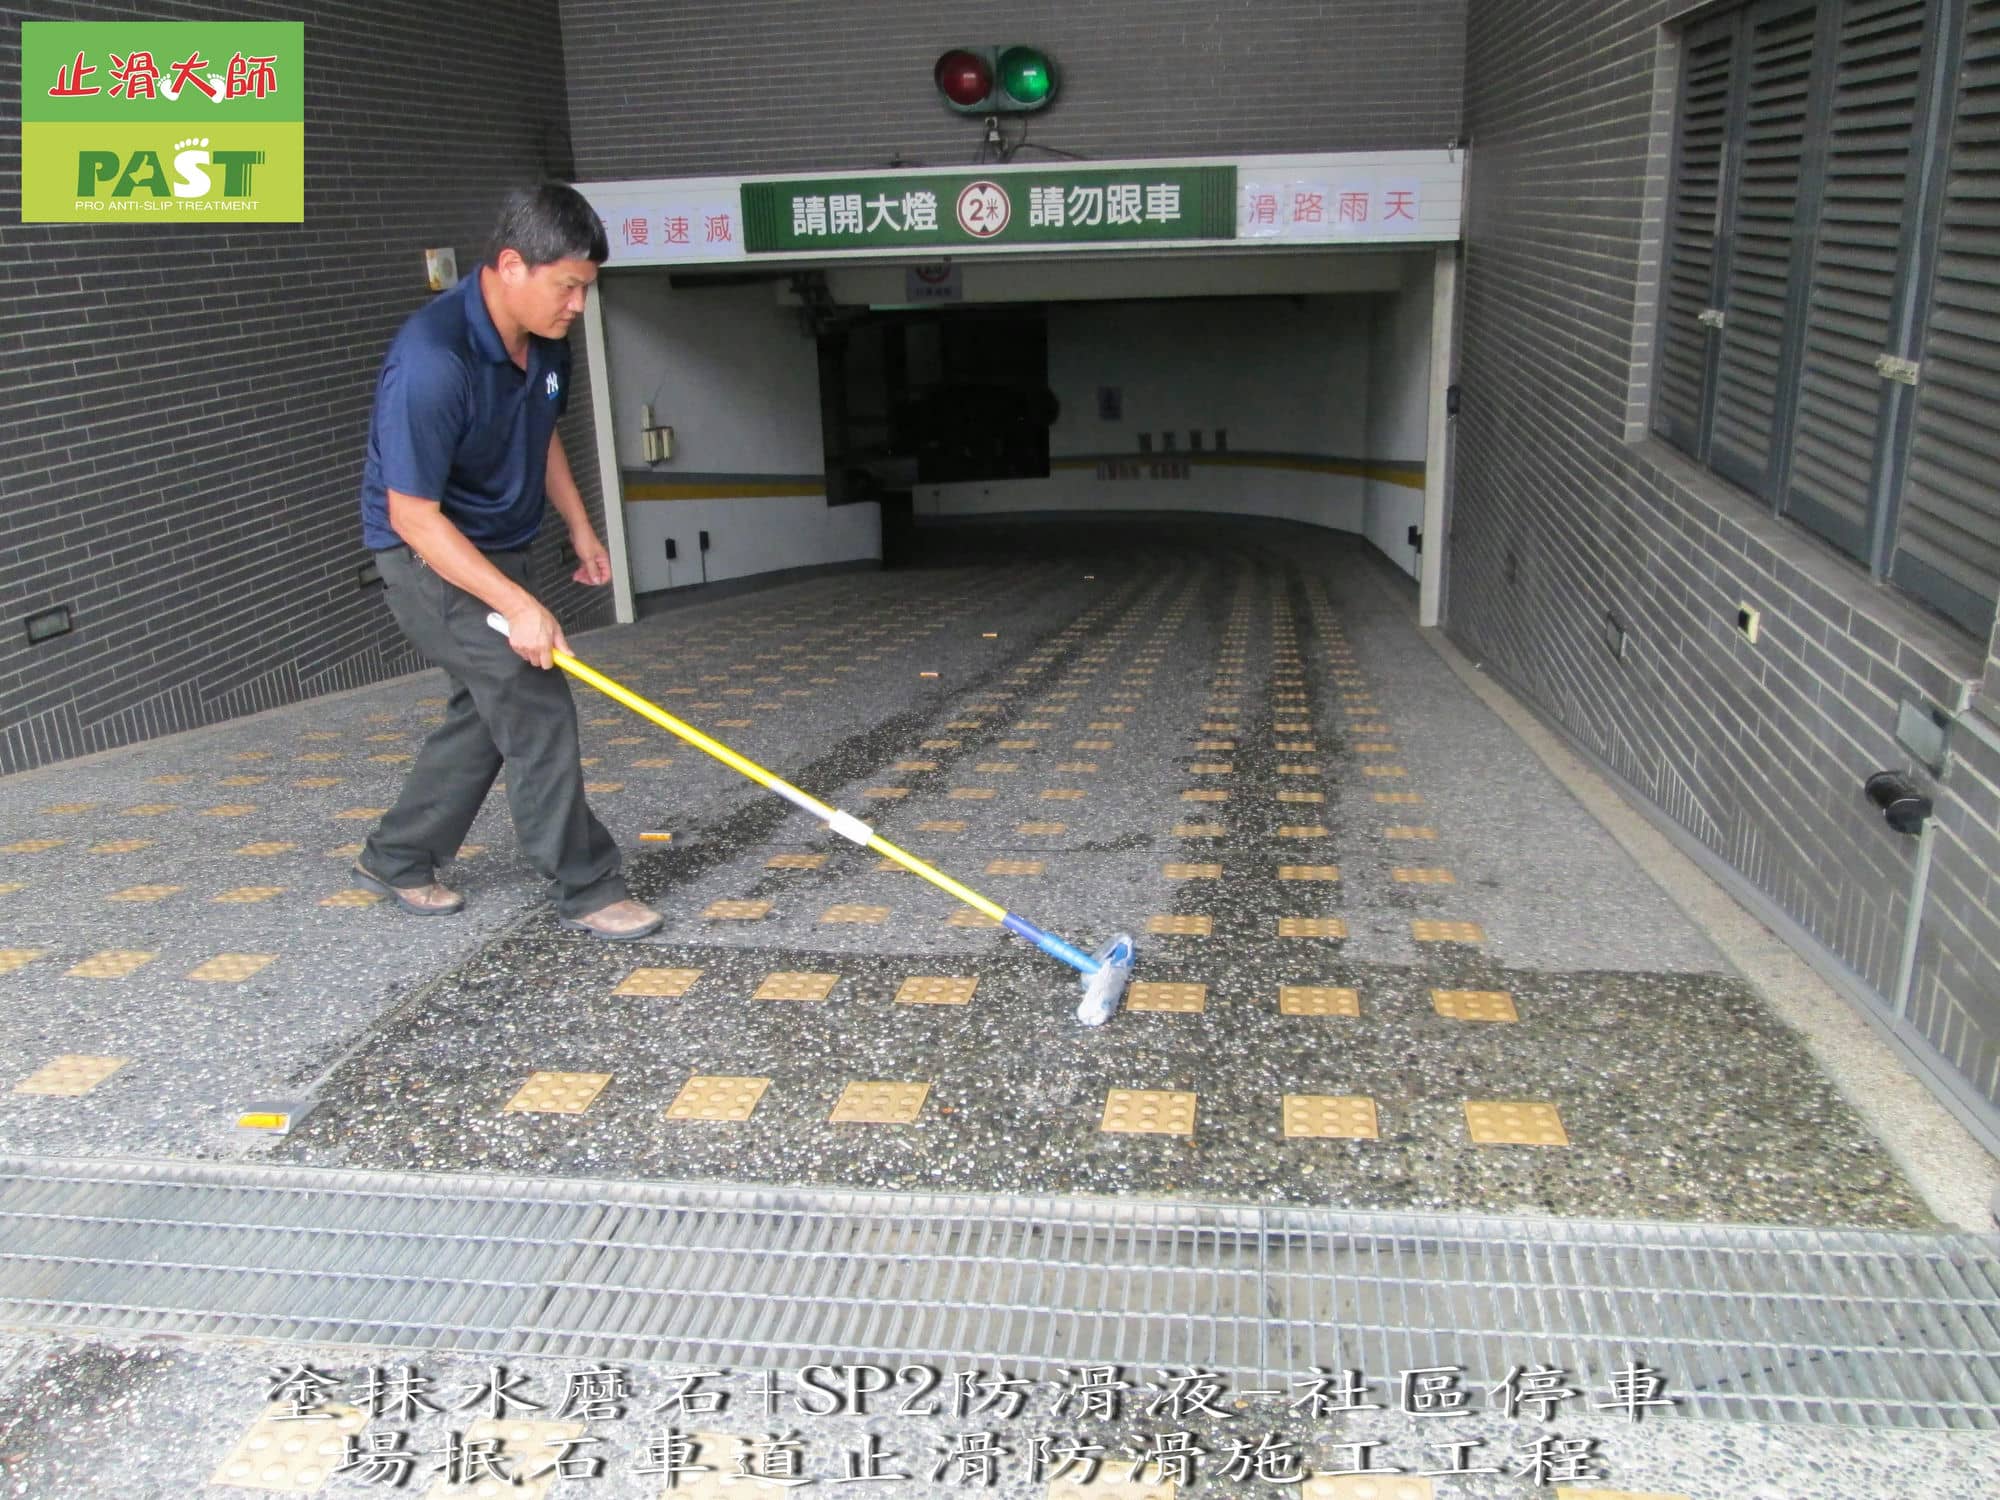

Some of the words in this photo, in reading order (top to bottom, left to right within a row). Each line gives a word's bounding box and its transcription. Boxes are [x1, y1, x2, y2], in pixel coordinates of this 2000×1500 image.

[792, 193, 938, 237] 請開大燈
[1029, 183, 1182, 227] 請勿跟車
